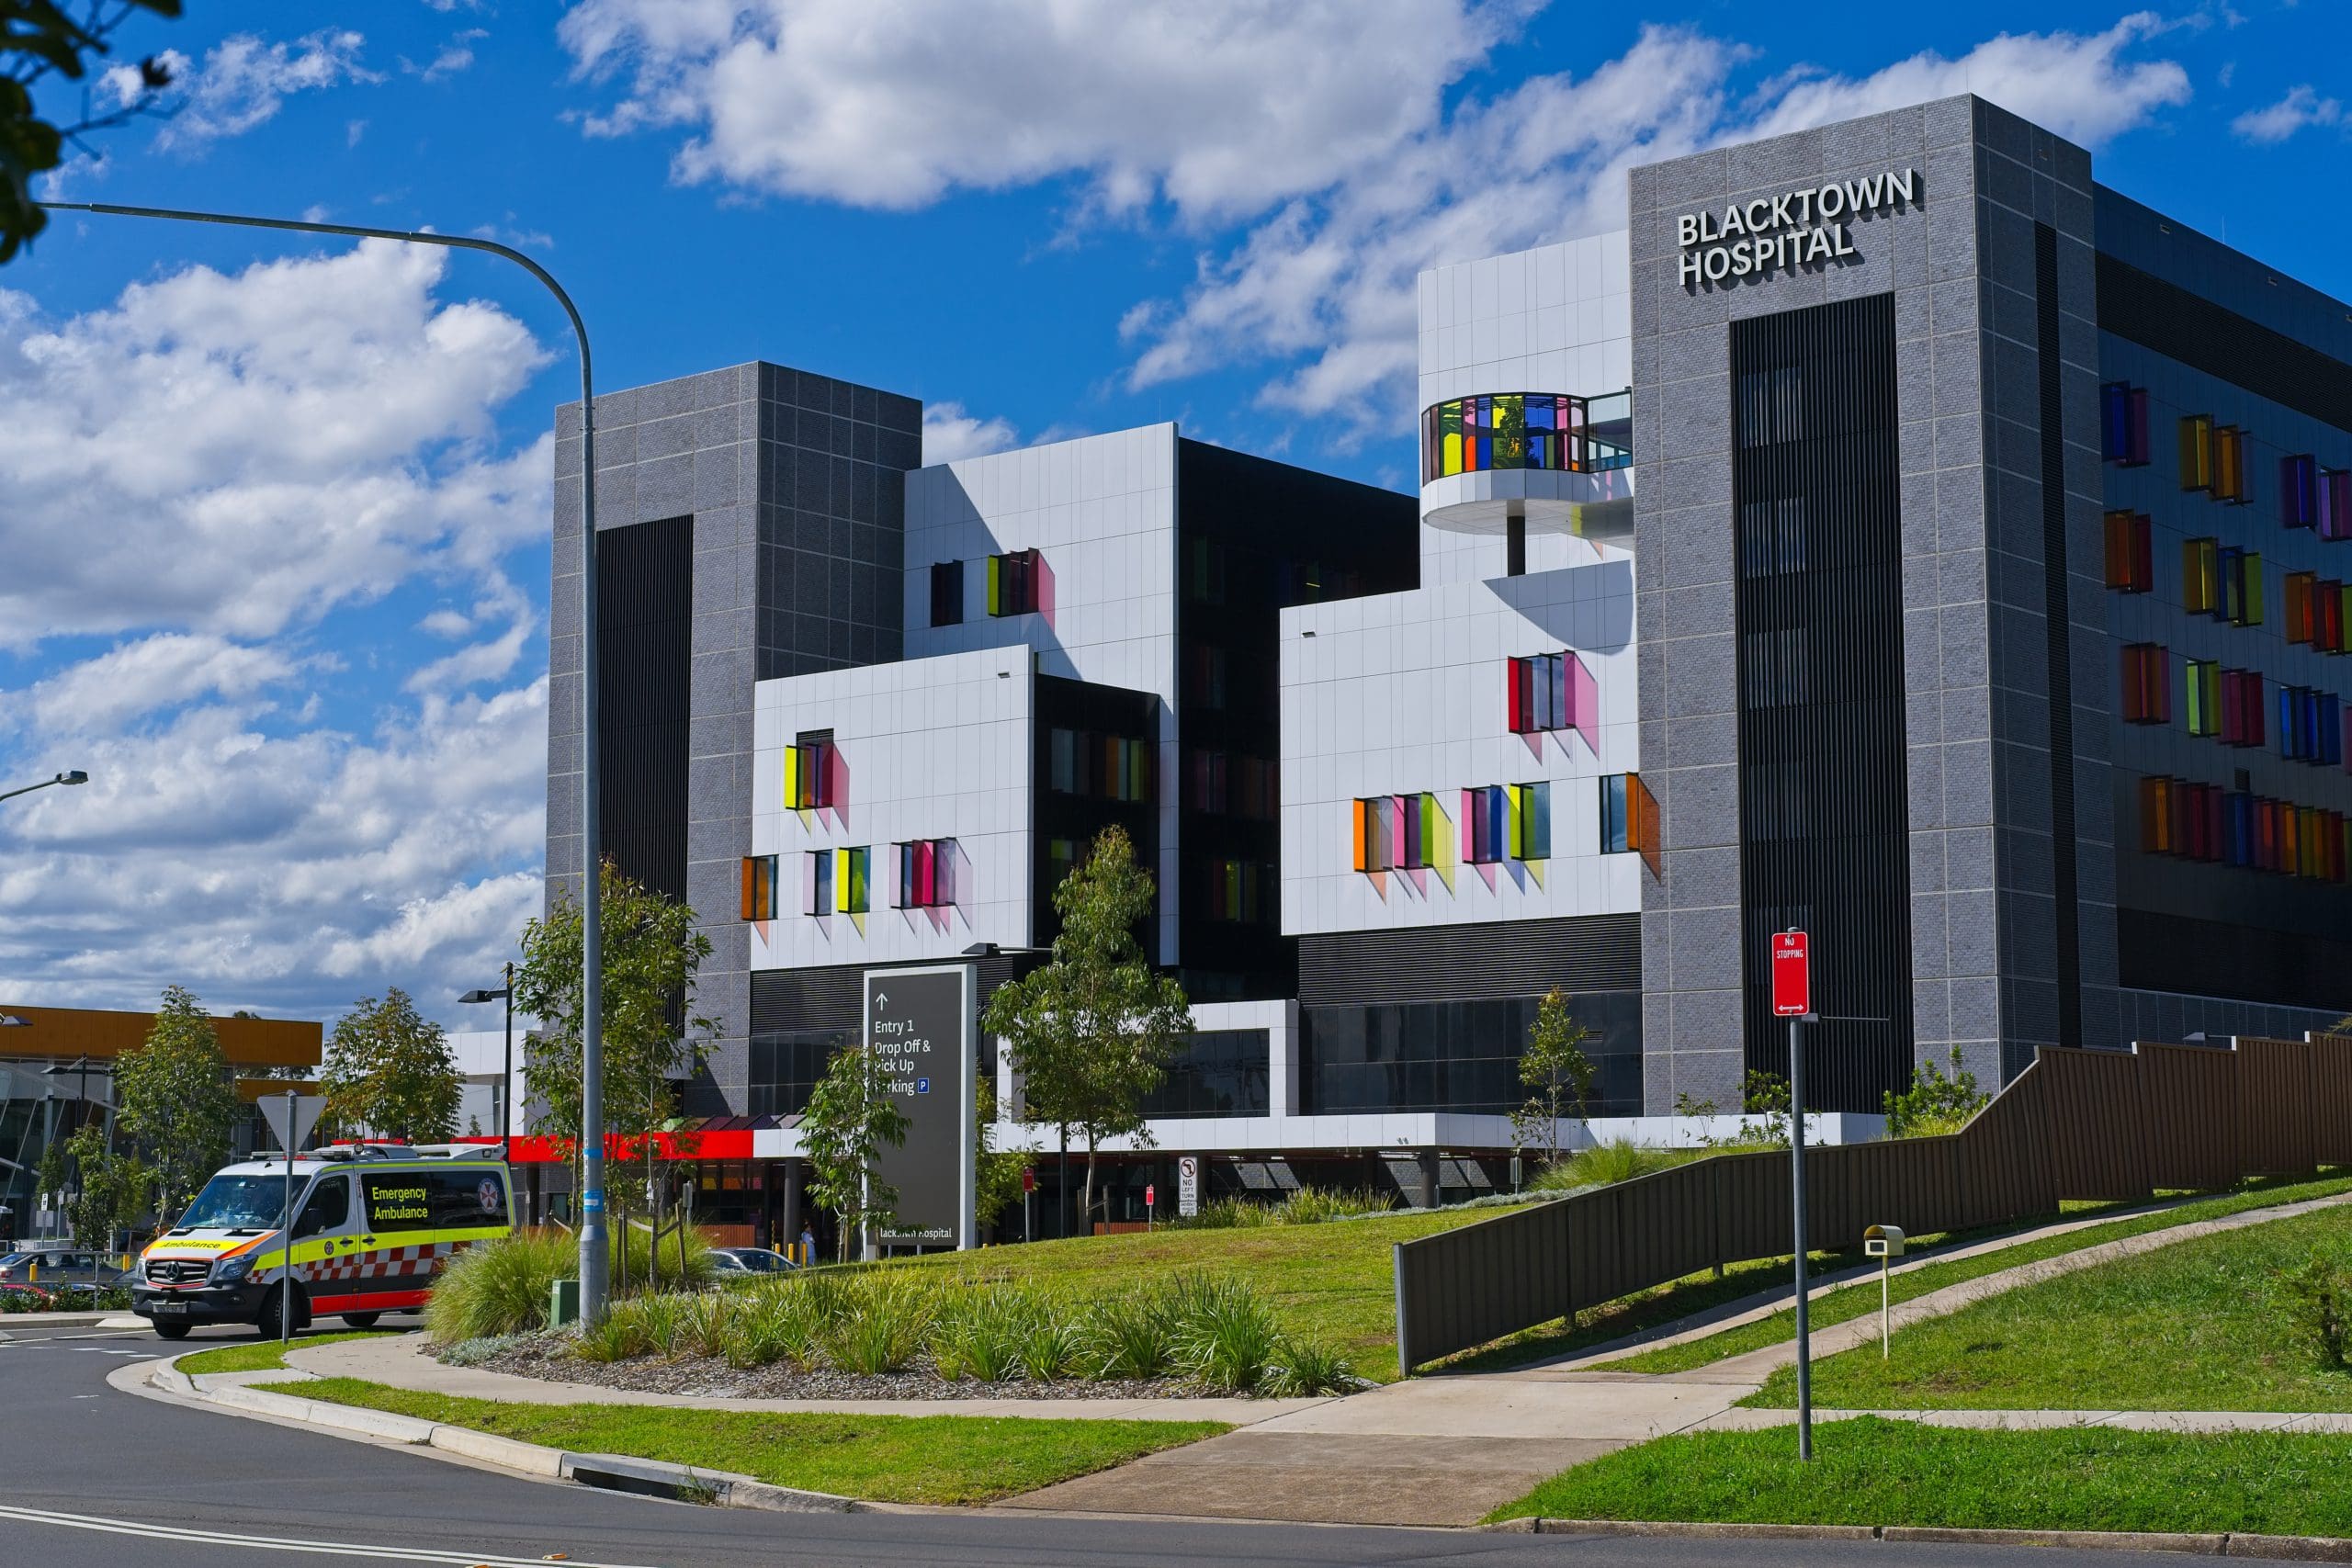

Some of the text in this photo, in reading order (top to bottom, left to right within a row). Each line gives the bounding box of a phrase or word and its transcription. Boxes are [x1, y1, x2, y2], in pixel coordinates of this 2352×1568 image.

[1678, 168, 1914, 246] BLACKTOWN
[1678, 223, 1854, 286] HOSPITAL
[1785, 937, 1795, 946] NO
[1776, 949, 1804, 959] STOPPING
[875, 1020, 914, 1036] Entry 1
[875, 1038, 931, 1057] Drop Off &
[899, 1058, 915, 1075] Up
[371, 1186, 427, 1202] Emergency
[374, 1205, 428, 1221] Ambulance
[162, 1241, 221, 1249] Ambulance
